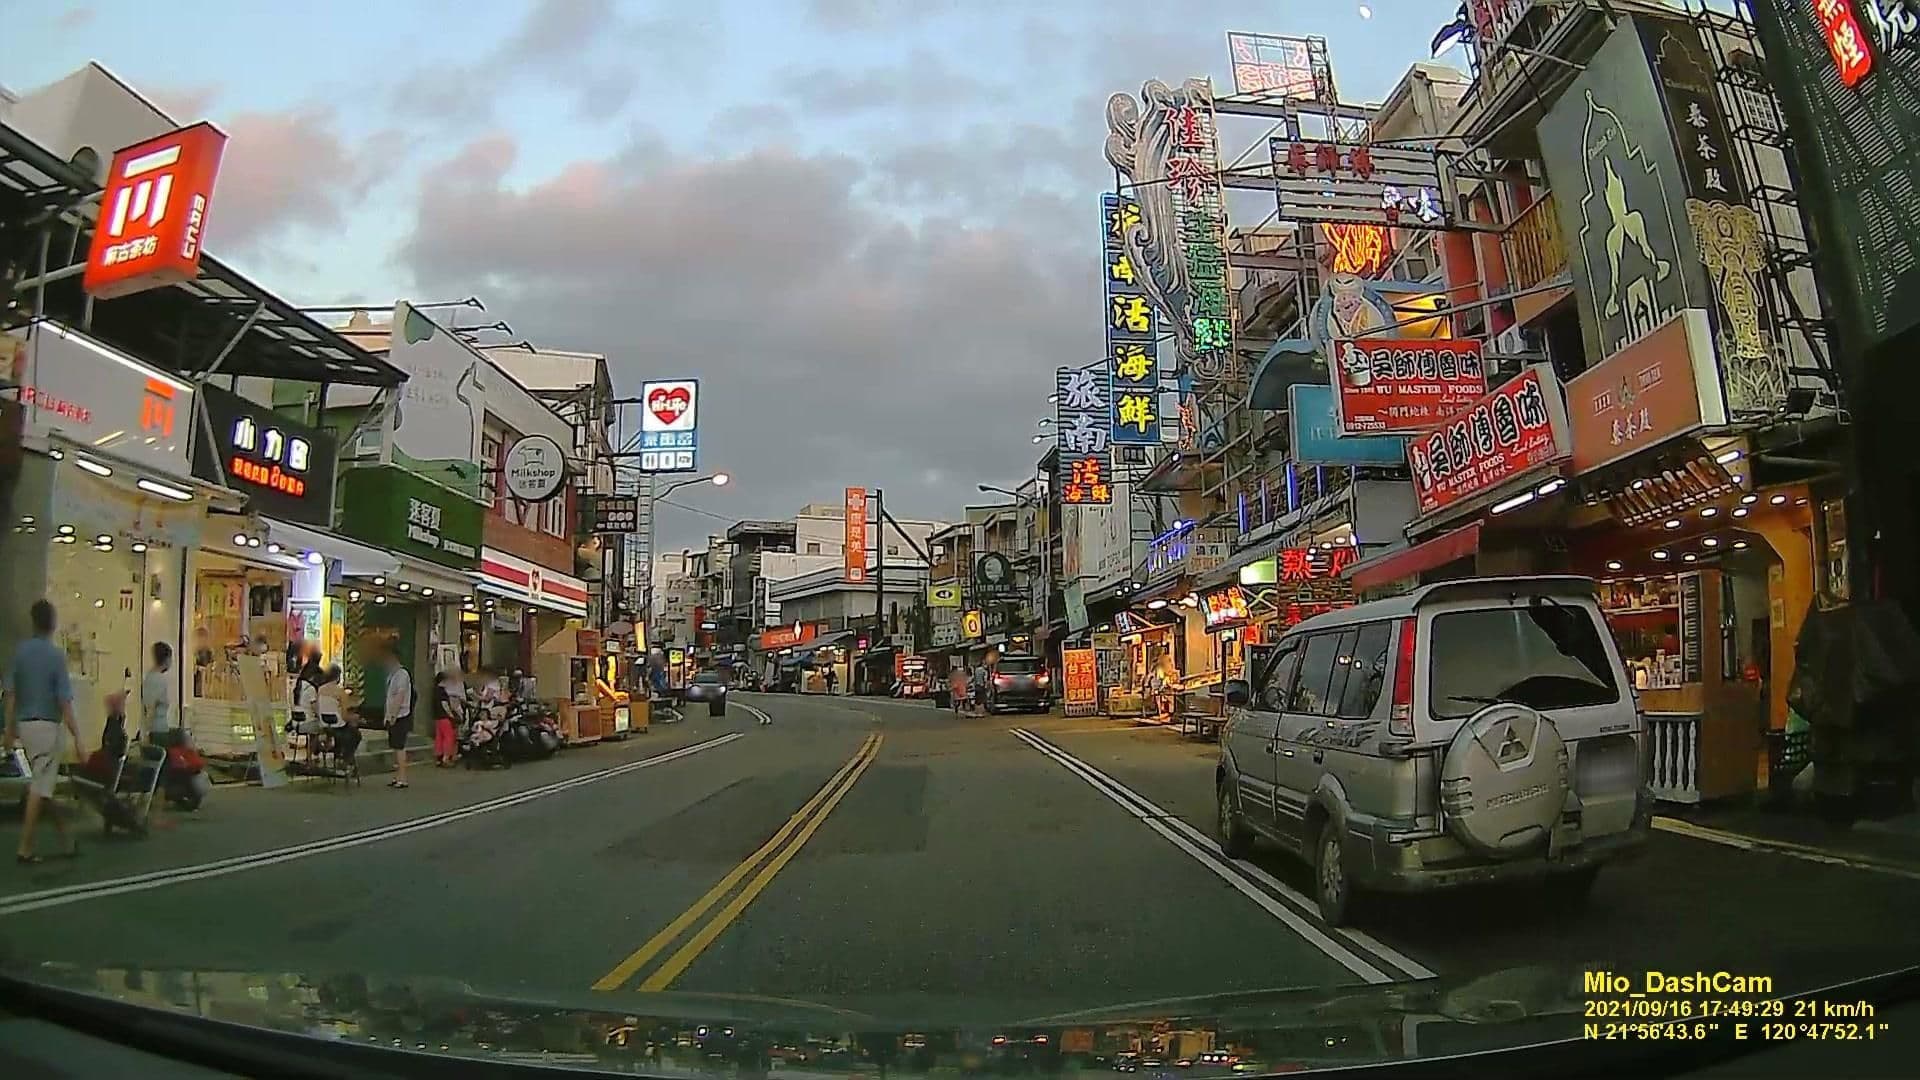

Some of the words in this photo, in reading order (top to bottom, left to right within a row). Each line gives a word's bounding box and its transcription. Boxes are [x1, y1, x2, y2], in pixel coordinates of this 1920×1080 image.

[1375, 384, 1393, 395] WU
[1397, 384, 1443, 395] MASTER
[1448, 384, 1484, 395] FOODS
[511, 467, 556, 479] Milkshop
[1447, 470, 1478, 488] MASTER
[1478, 452, 1506, 472] FOODS
